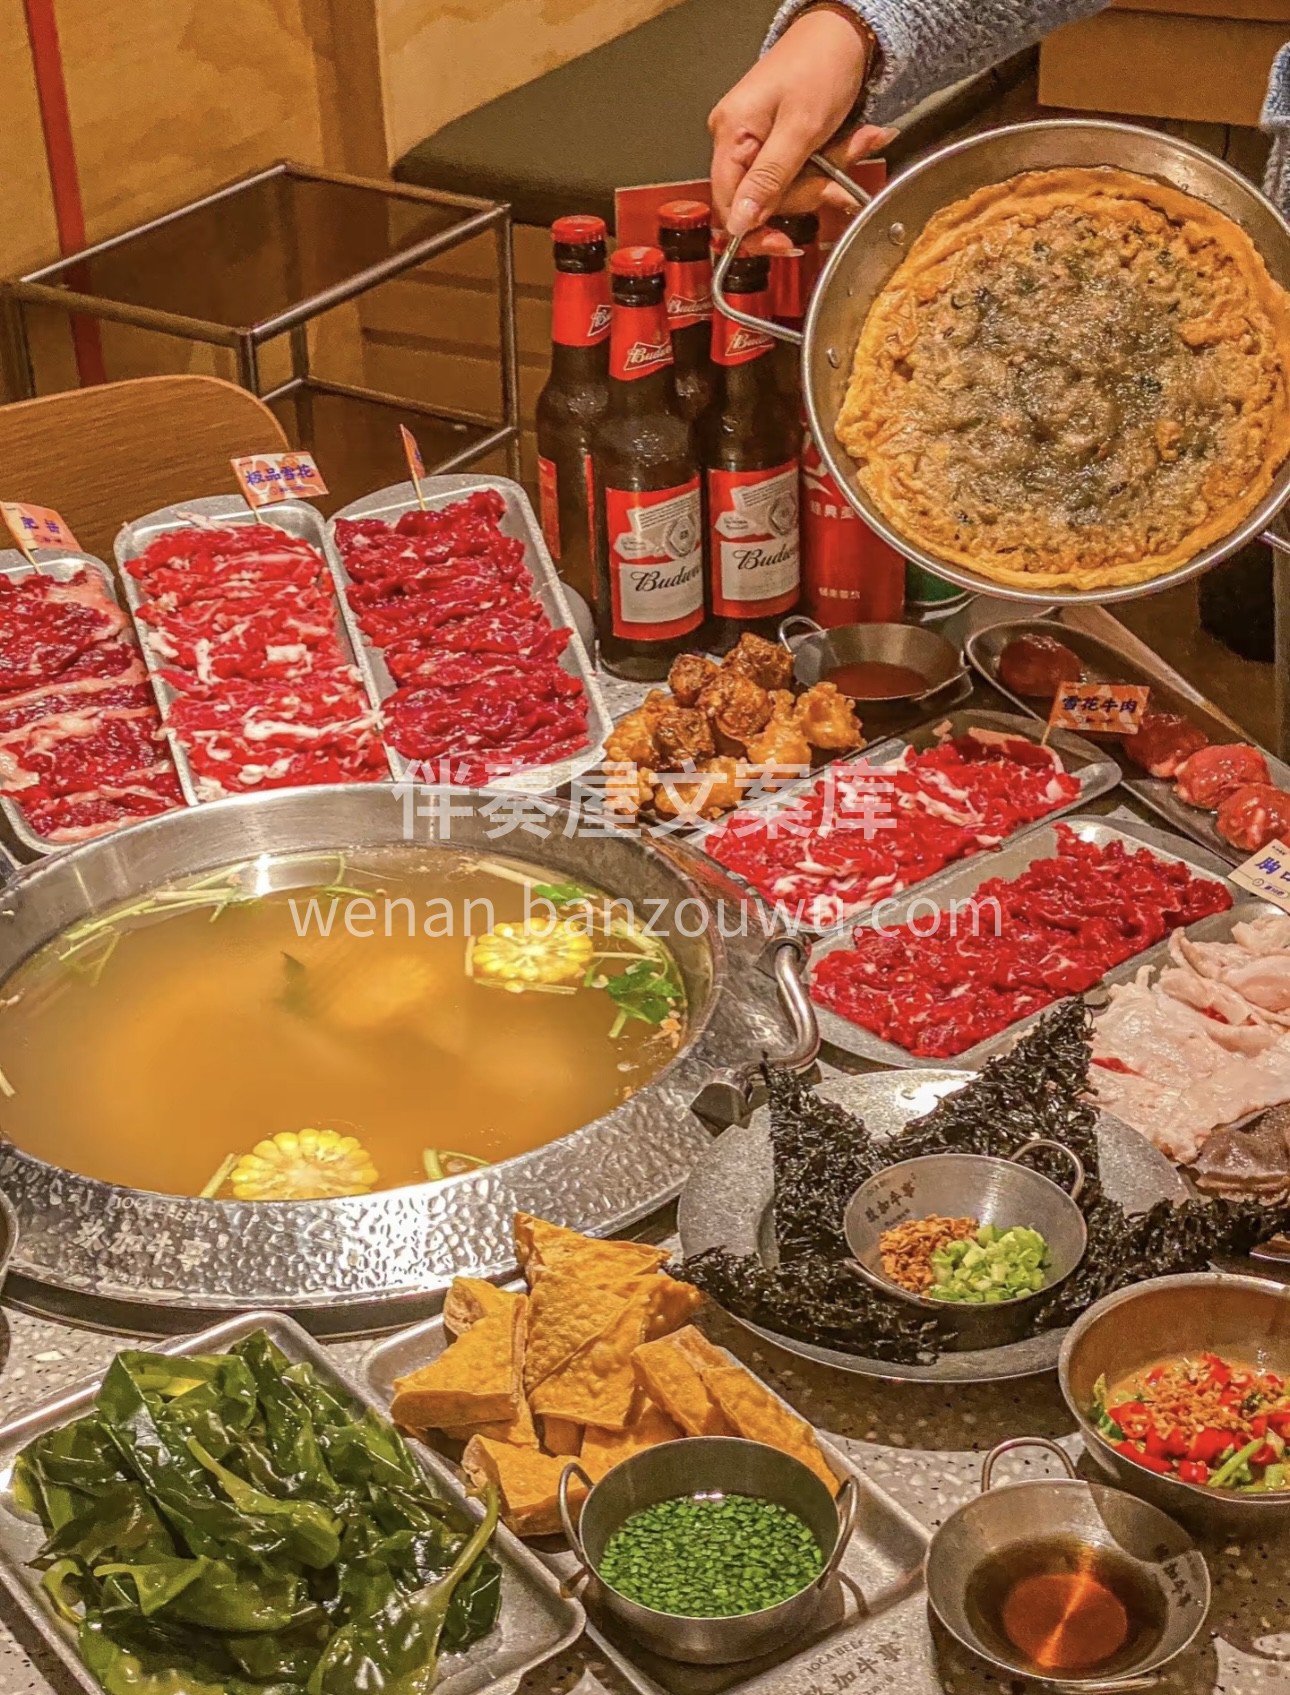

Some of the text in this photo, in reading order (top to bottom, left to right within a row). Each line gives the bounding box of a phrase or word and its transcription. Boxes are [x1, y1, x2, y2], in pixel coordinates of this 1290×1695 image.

[246, 463, 315, 485] 极品雪花
[1061, 695, 1138, 713] 雪花牛肉
